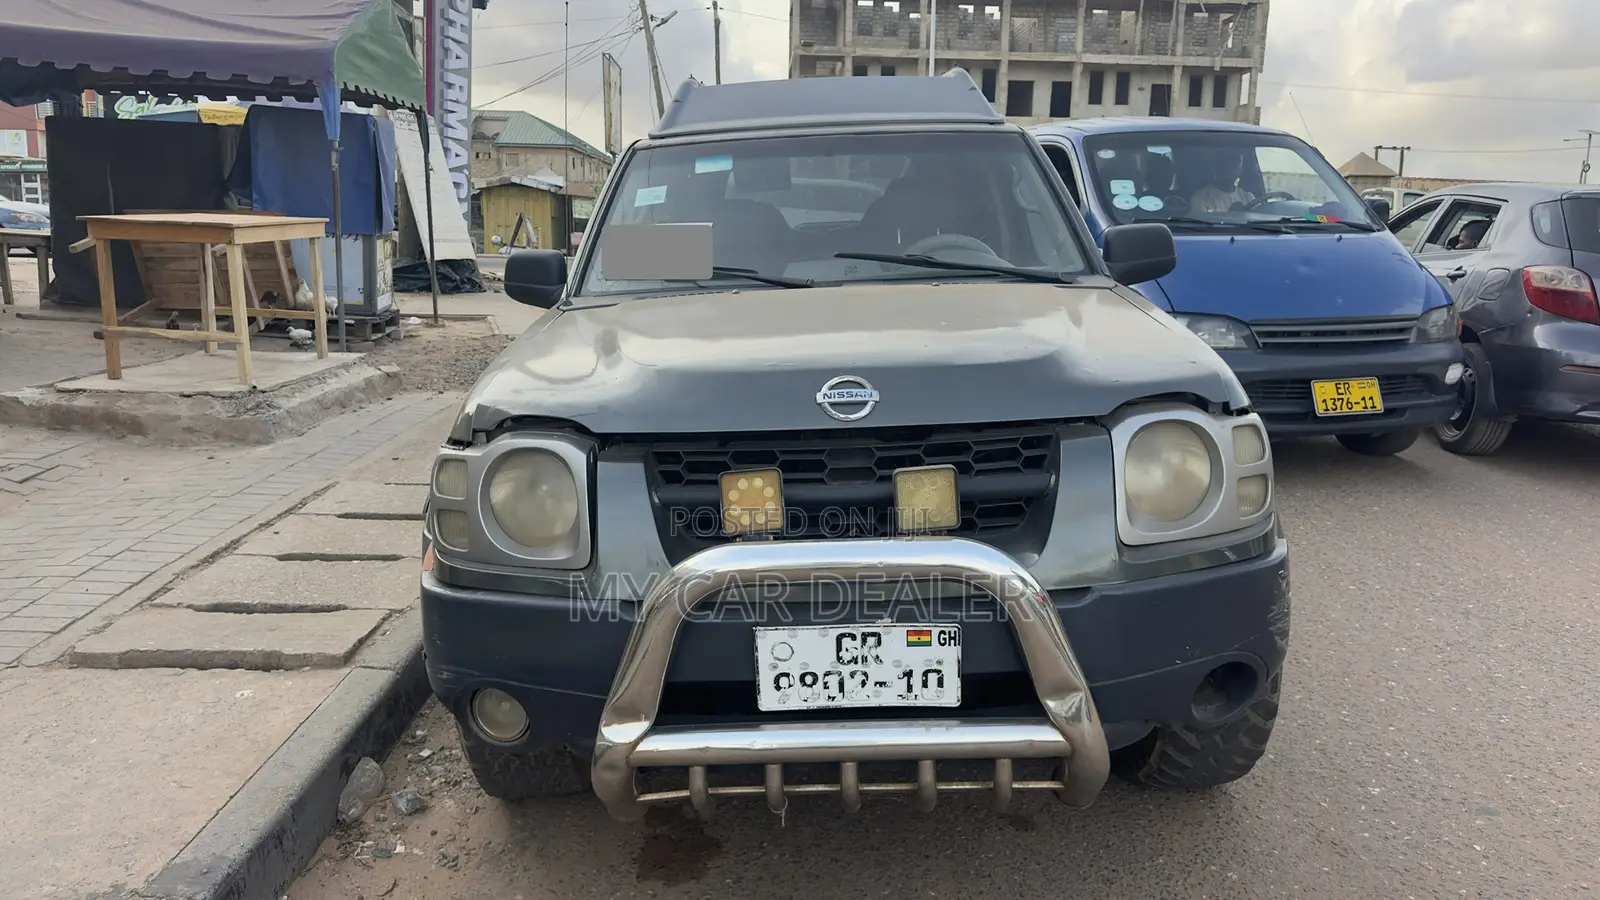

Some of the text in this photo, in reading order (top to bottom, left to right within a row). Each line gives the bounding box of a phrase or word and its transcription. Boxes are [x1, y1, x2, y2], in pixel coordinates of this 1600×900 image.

[823, 391, 874, 399] NISSAN
[1335, 382, 1352, 395] ER
[1321, 396, 1377, 412] 1376-11
[835, 629, 957, 666] GR GH
